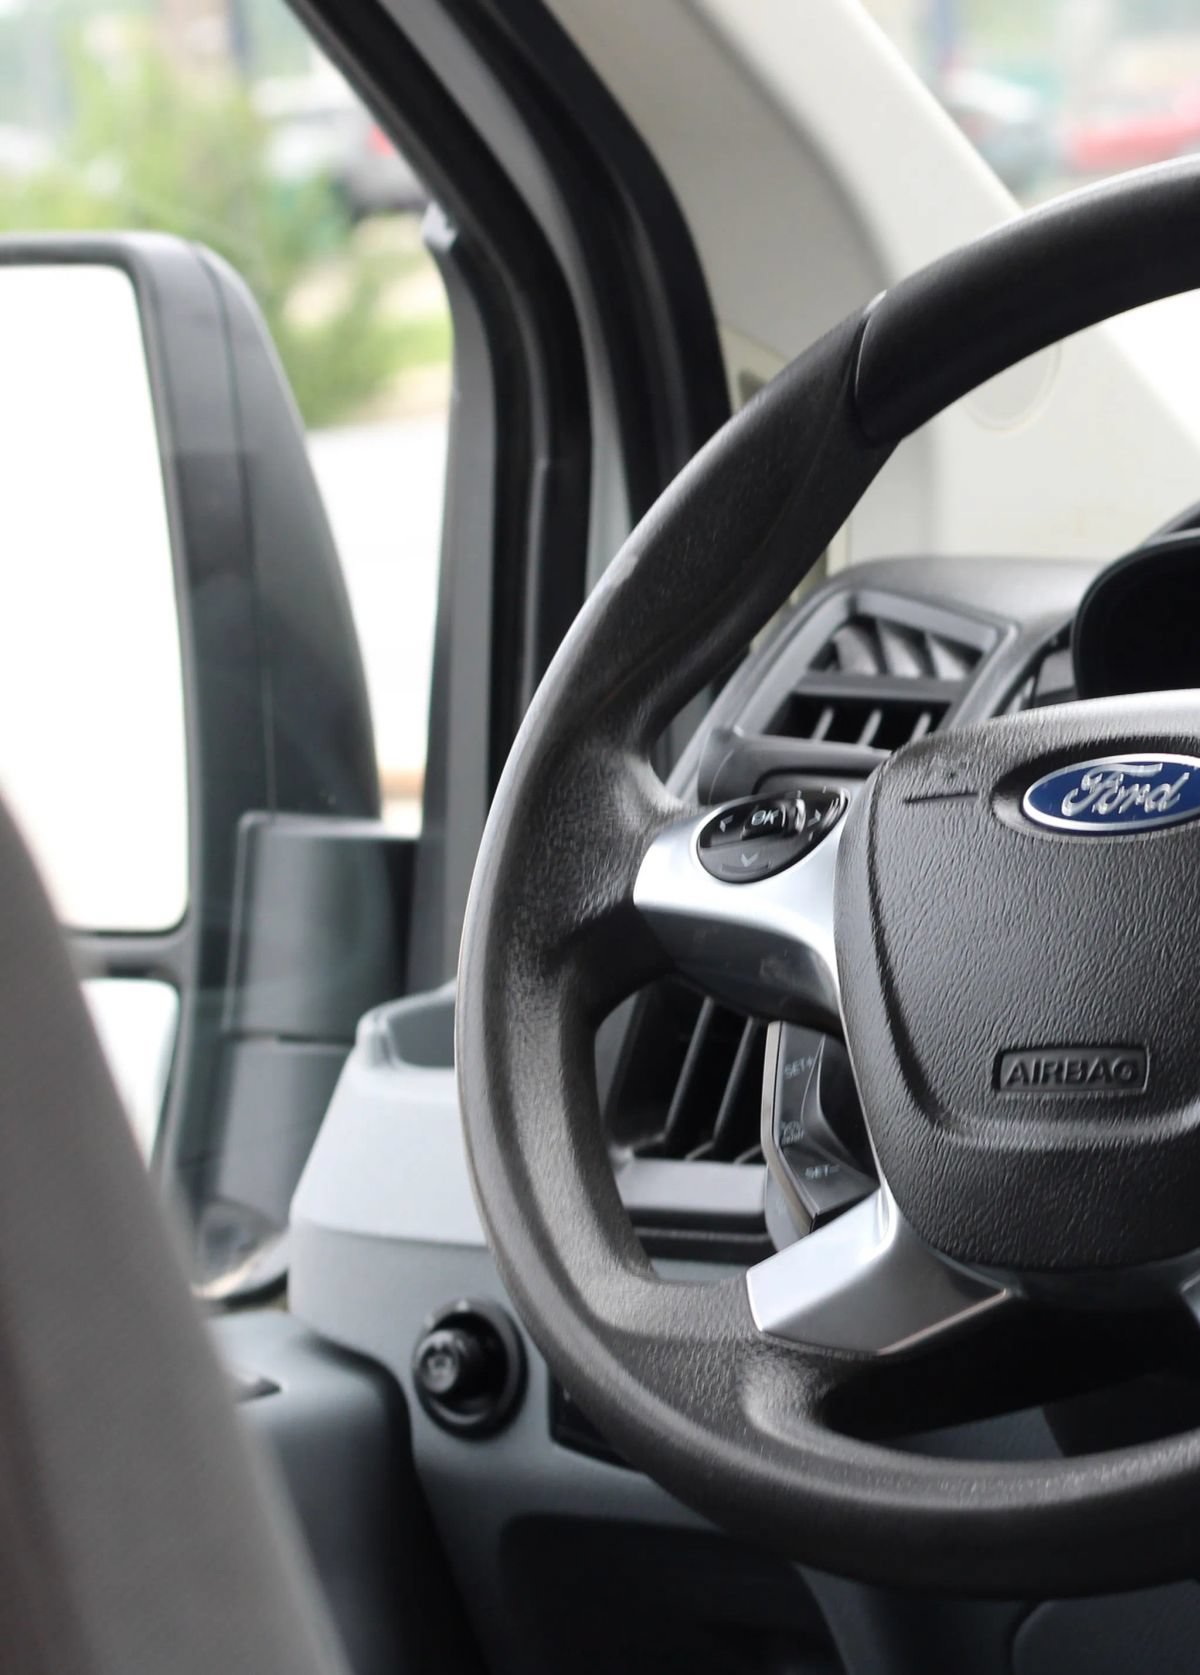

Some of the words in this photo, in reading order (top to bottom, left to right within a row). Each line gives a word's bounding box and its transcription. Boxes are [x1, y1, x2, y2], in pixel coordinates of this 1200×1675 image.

[1061, 763, 1190, 817] Ford
[751, 808, 780, 826] OK
[1005, 1056, 1140, 1086] AIRBAG
